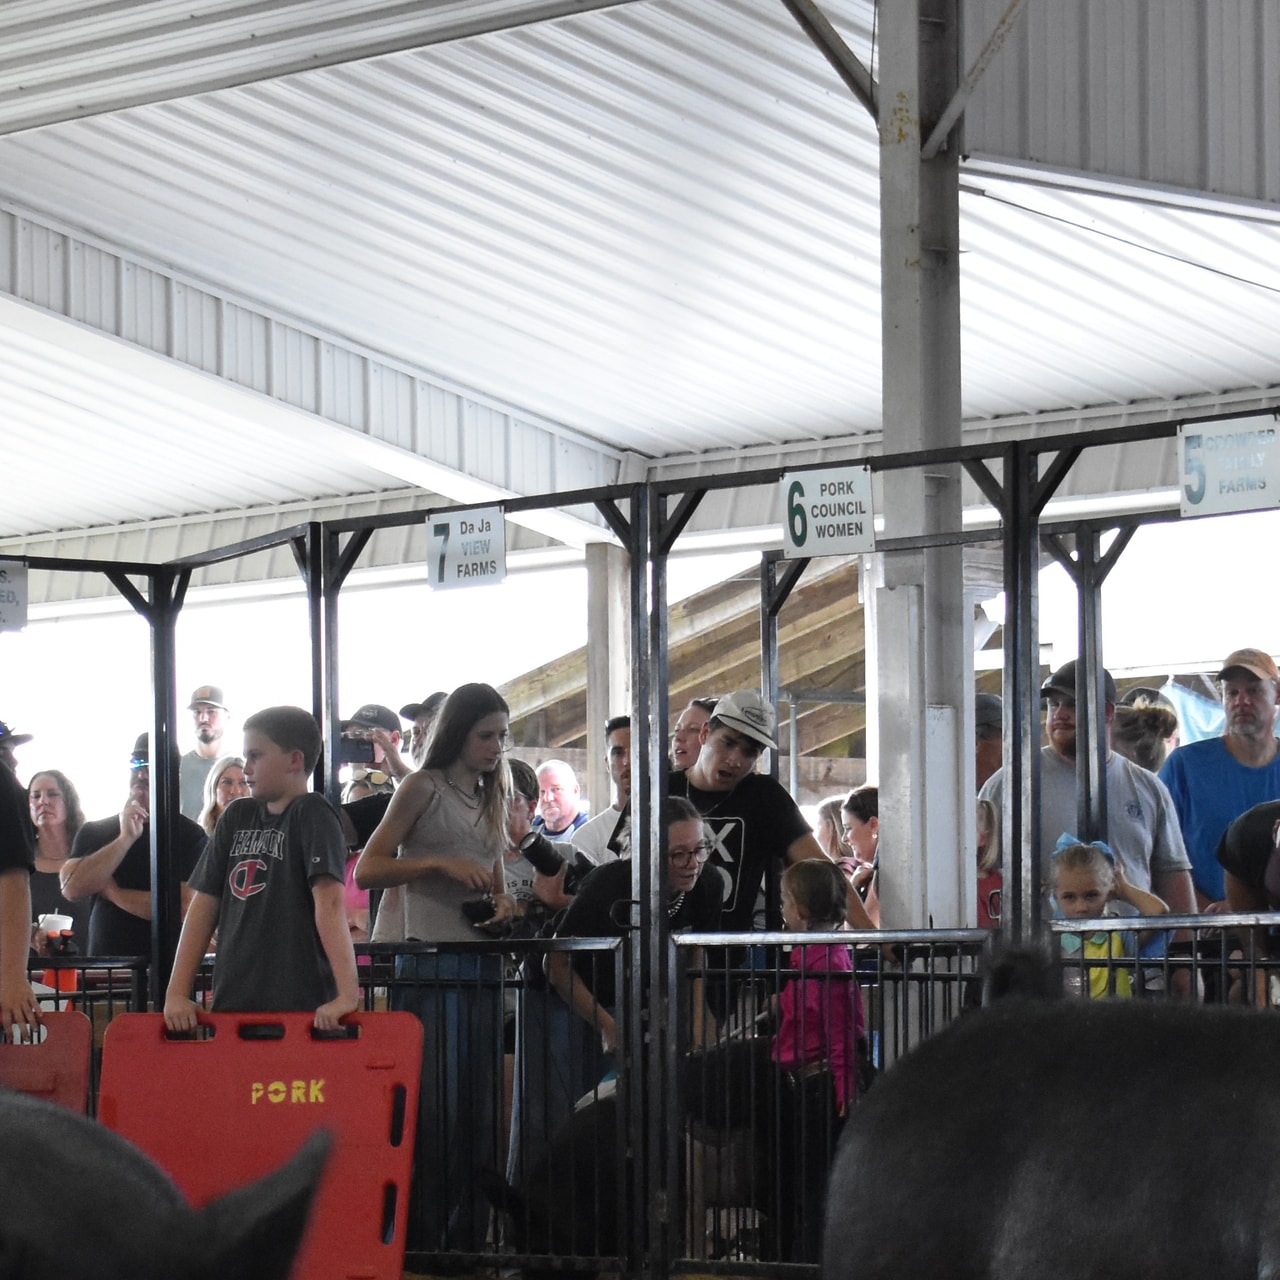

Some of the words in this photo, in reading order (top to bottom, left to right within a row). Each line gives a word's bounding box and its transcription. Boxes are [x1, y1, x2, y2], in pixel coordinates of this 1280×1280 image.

[1184, 434, 1206, 505] 5
[820, 481, 854, 496] PORK
[1219, 475, 1266, 494] FARMS
[787, 480, 807, 548] 6
[811, 501, 866, 518] COUNCIL
[816, 522, 863, 538] WOMEN
[433, 522, 450, 583] 7
[461, 539, 491, 556] VIEW
[457, 560, 497, 578] FARMS
[251, 1079, 325, 1105] PORK
